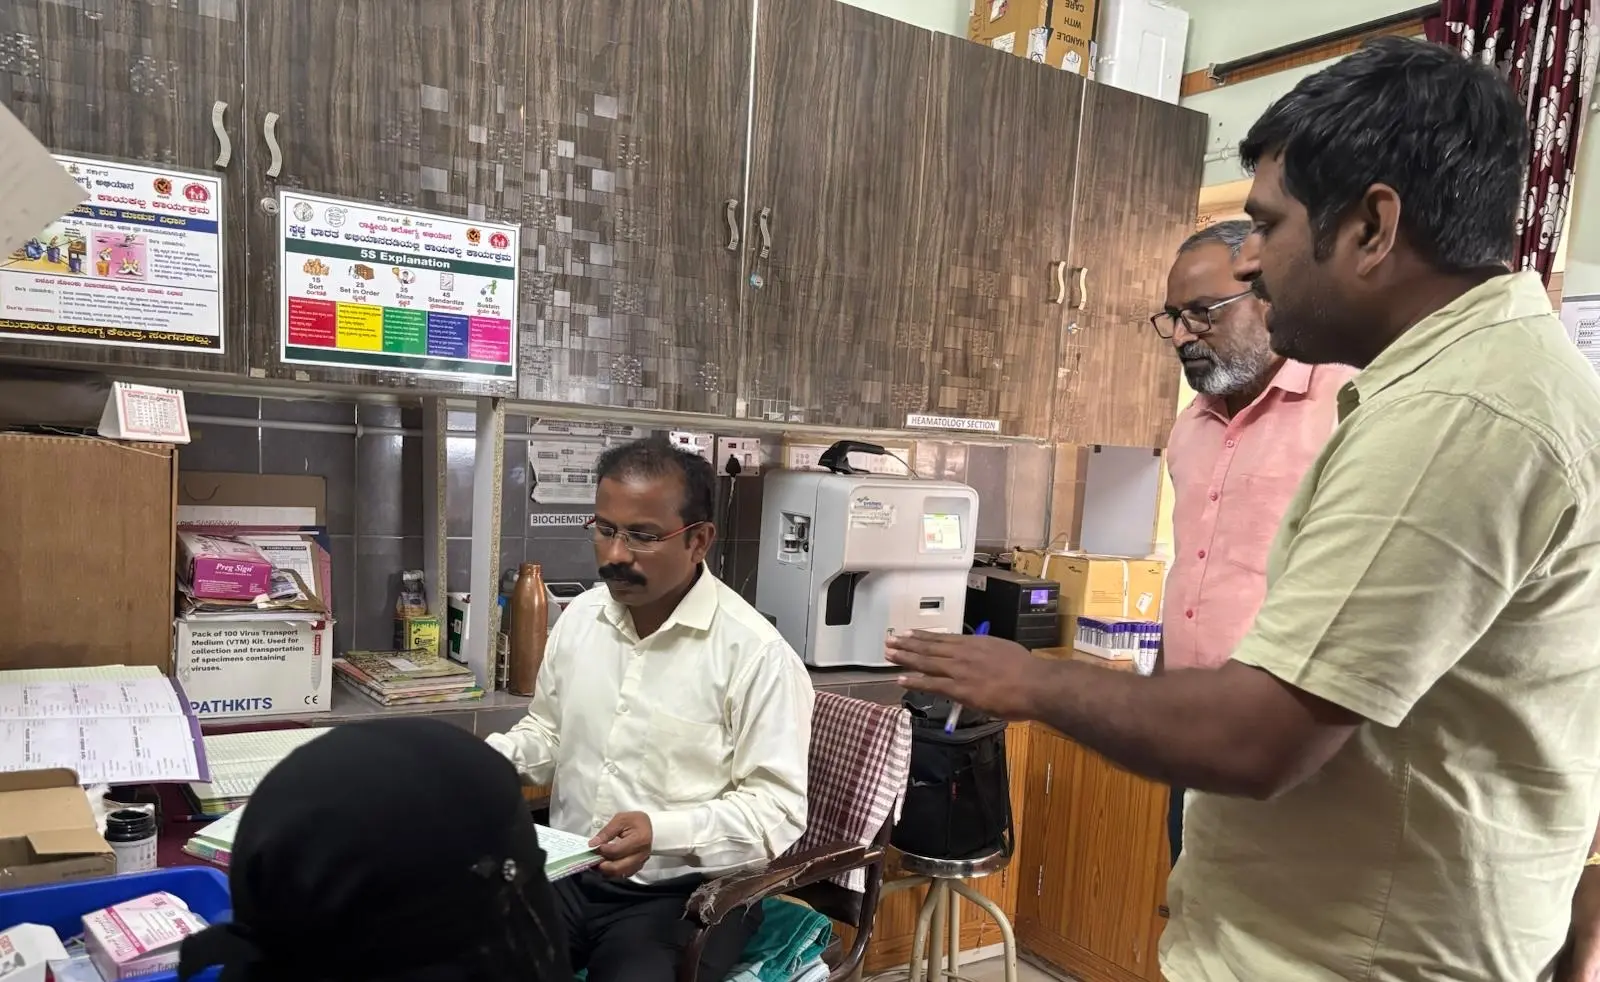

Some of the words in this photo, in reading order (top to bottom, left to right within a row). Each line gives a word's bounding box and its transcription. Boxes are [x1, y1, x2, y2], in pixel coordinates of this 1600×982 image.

[1064, 2, 1084, 13] CARE
[1064, 16, 1082, 30] WITH
[1056, 32, 1084, 47] HANDLE
[152, 201, 210, 216] ಕಾರ್ಯಕ್ರಮ
[311, 228, 339, 238] ಭಾರತ
[424, 244, 462, 258] ಕಾಯಕಲ್ಪ
[467, 249, 511, 262] ಕಾರ್ಯಕ್ರಮ
[360, 250, 376, 258] 5S
[380, 252, 450, 268] Explanation
[361, 288, 380, 296] Order
[428, 297, 464, 306] Standardize
[912, 416, 966, 428] HEAMATOLOGY
[967, 420, 996, 429] SECTION
[216, 563, 233, 572] Preg
[235, 564, 252, 573] Sign
[190, 697, 272, 713] PATHKITS
